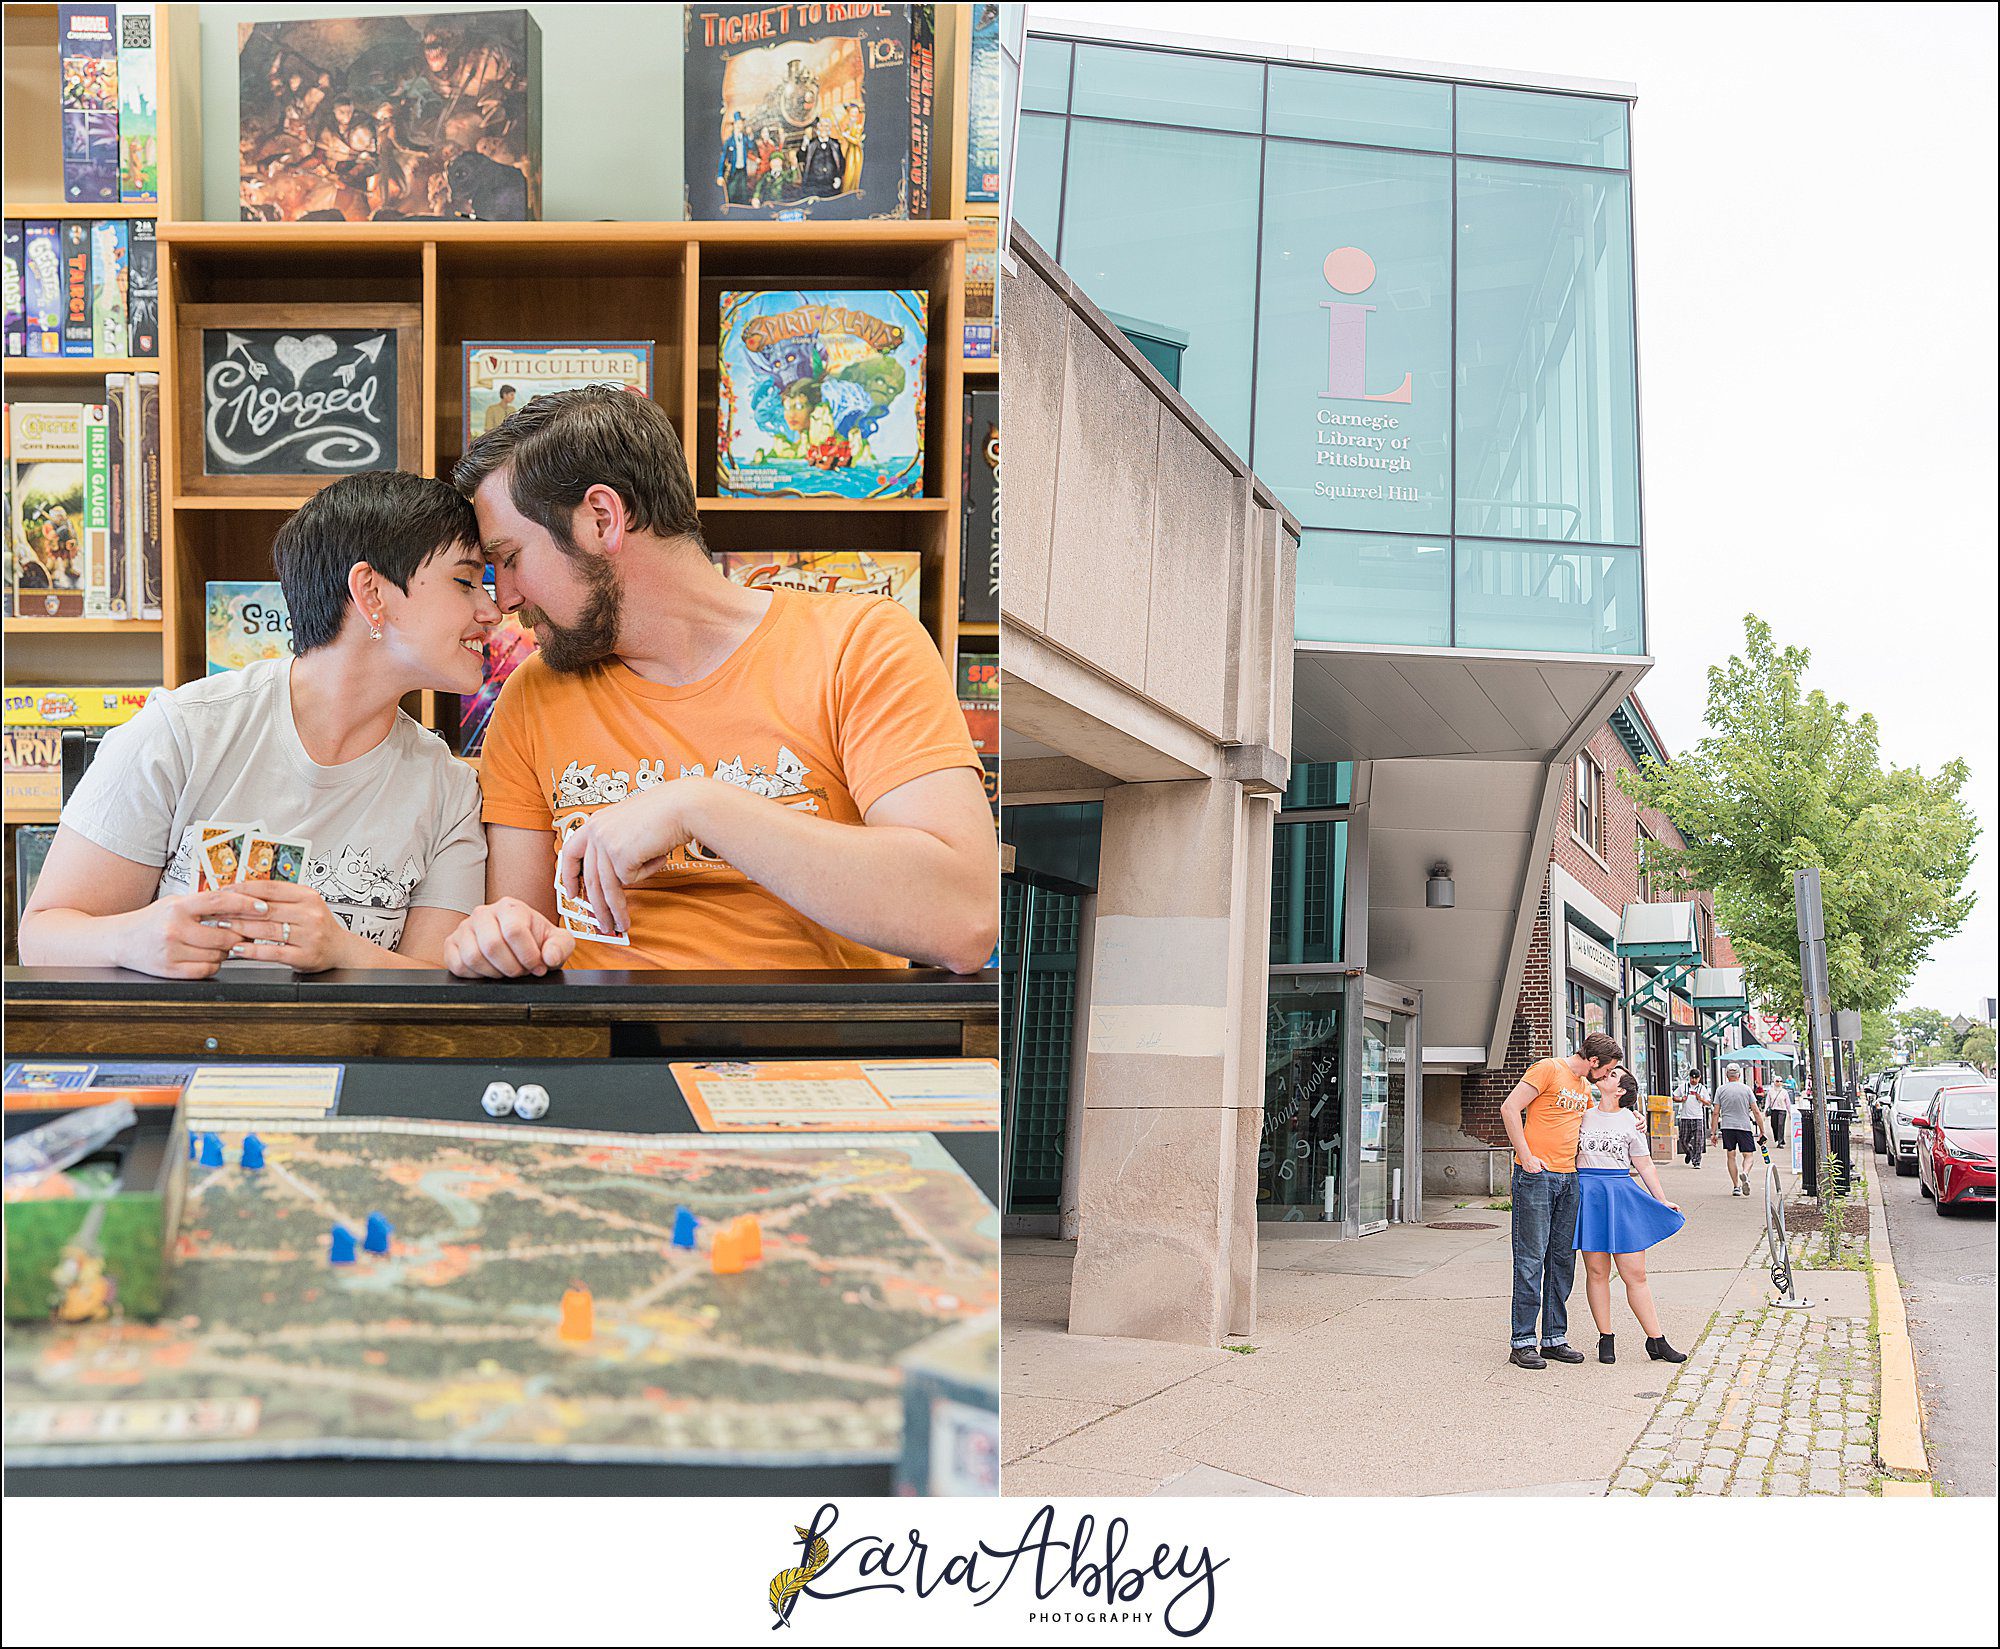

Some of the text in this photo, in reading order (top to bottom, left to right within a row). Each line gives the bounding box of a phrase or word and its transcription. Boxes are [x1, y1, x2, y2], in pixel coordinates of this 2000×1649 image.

[124, 19, 149, 30] NEW
[700, 5, 793, 47] TICKET
[797, 4, 822, 27] TO
[123, 36, 151, 47] ZOO
[921, 43, 933, 96] RAIL
[910, 40, 922, 185] AVENTURIERS
[69, 254, 86, 322] TARGI
[750, 305, 896, 351] SPIRIT ISLAND
[486, 356, 634, 375] VITICULTURE
[207, 360, 381, 458] Engaged
[1316, 410, 1400, 430] Carnegie
[1317, 430, 1411, 452] Library of
[91, 428, 105, 526] IRISH GAUGE
[1316, 451, 1412, 474] Pittsburgh
[1315, 481, 1419, 502] Squirrel Hill
[122, 694, 147, 708] HAB
[1297, 1056, 1336, 1101] books.
